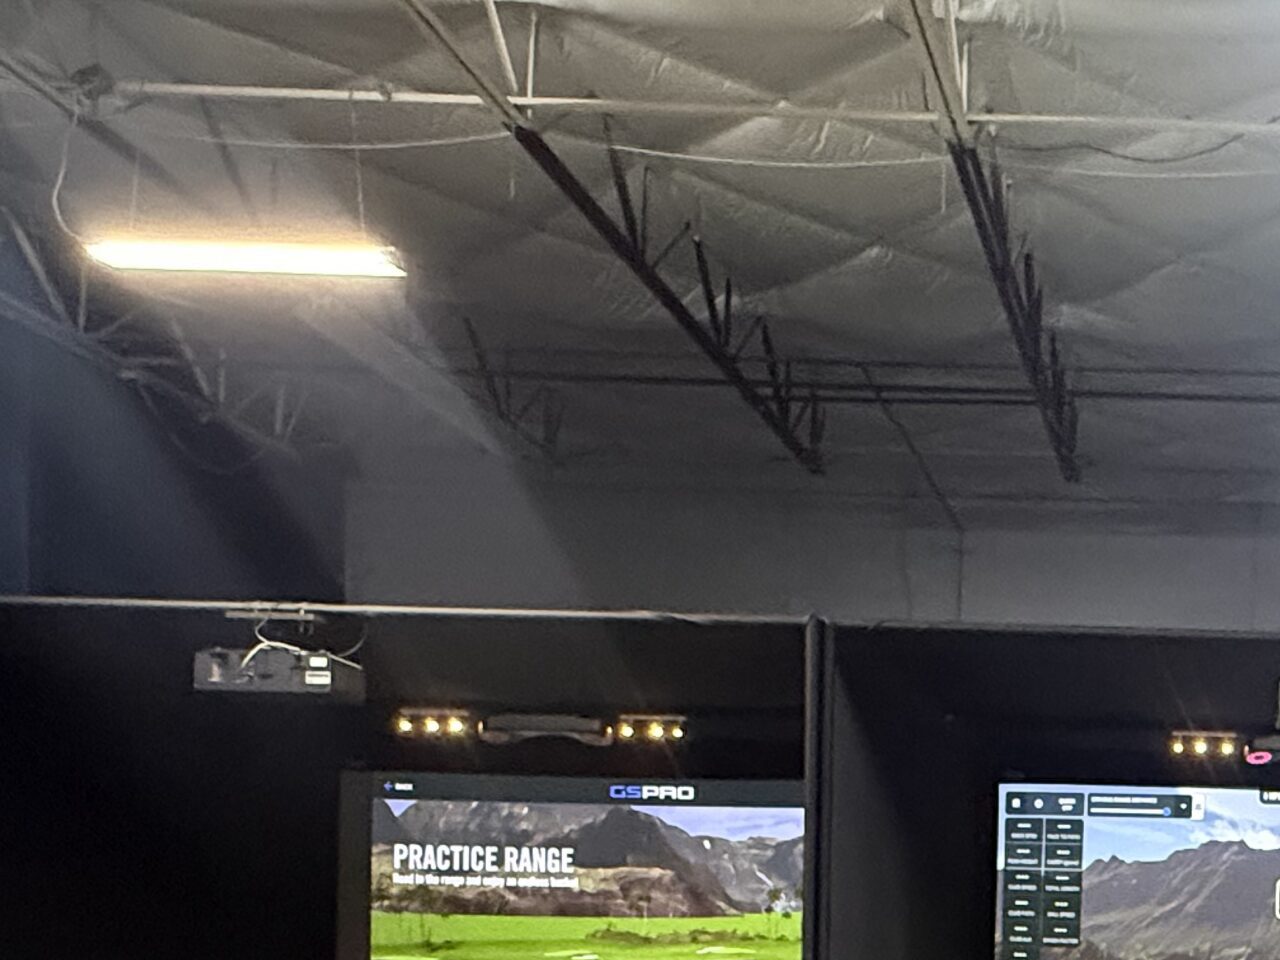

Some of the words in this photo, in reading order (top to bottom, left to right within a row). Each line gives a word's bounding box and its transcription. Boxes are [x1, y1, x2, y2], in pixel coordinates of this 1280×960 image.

[609, 785, 695, 800] GSPRO
[393, 844, 499, 872] PRACTICE
[504, 846, 575, 874] RANGE
